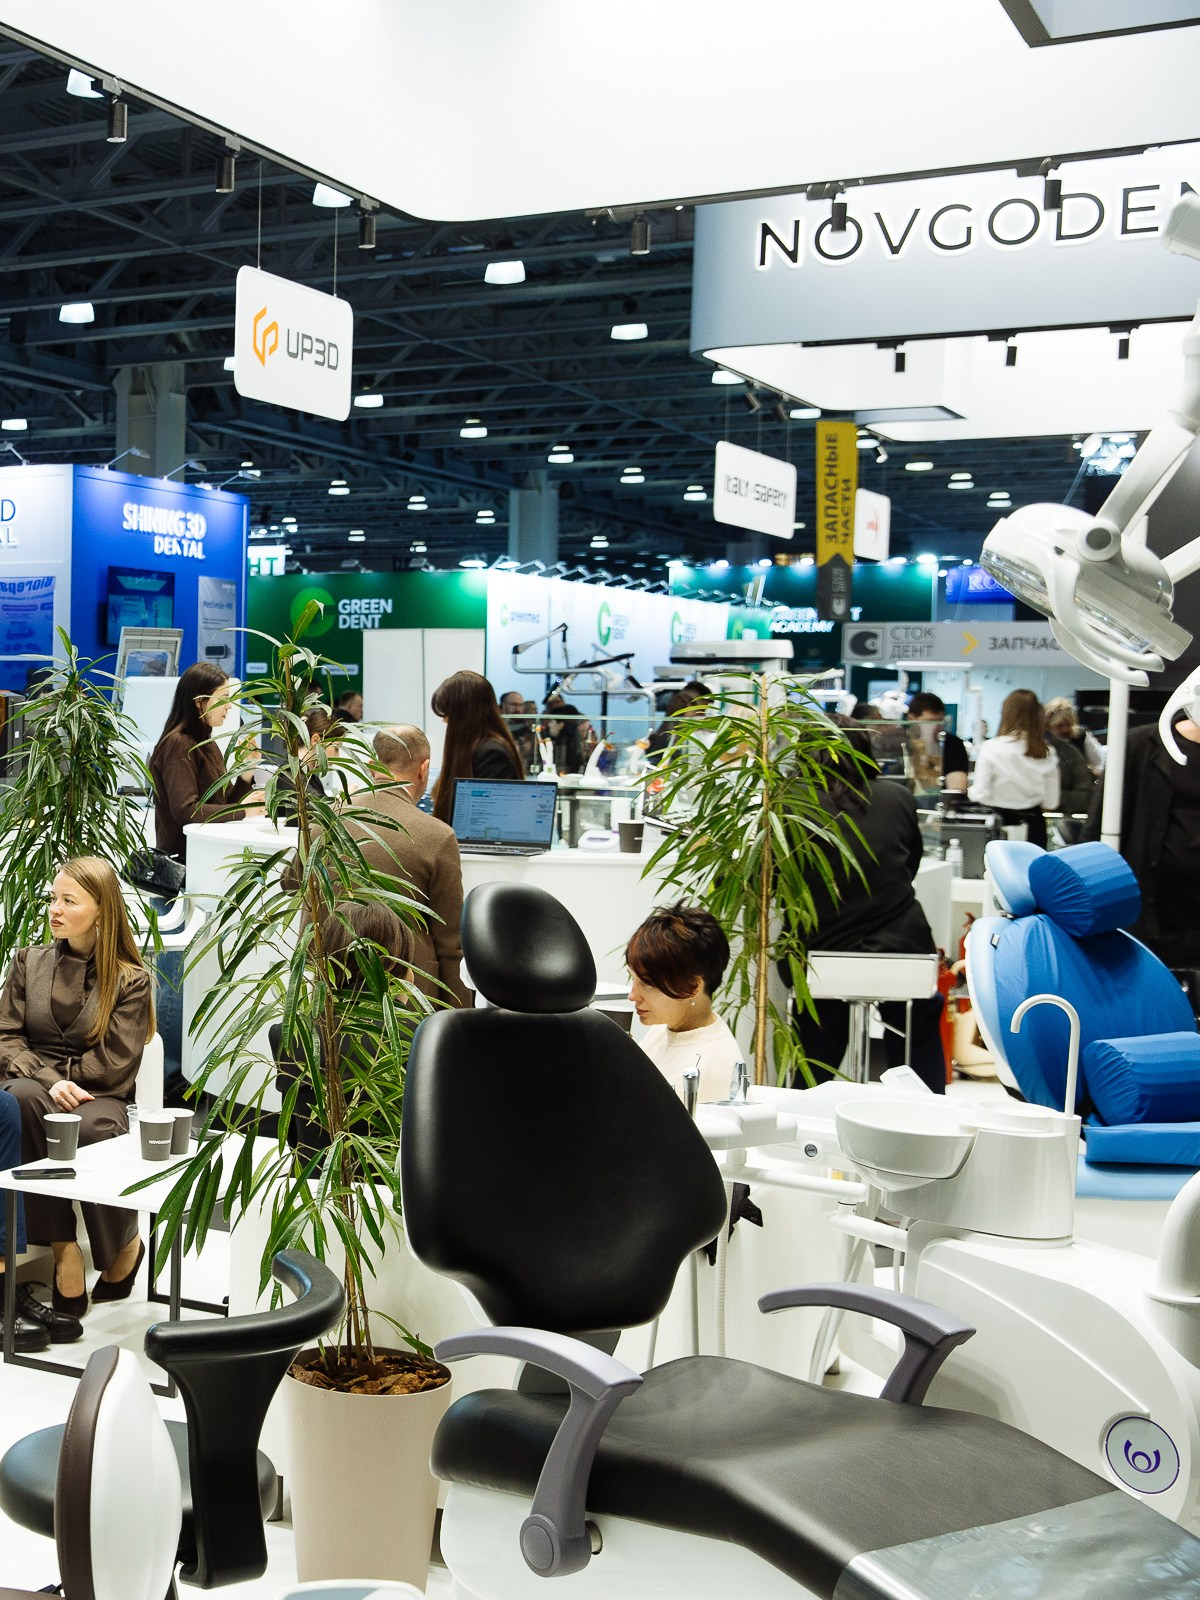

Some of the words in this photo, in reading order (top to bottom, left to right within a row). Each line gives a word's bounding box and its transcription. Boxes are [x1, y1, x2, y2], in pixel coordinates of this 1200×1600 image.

[759, 181, 1200, 267] NOVGODE
[286, 328, 339, 371] UP3D
[122, 502, 186, 538] SHINING
[185, 510, 207, 541] 3D
[154, 535, 206, 560] DENTAL
[338, 598, 393, 614] GREEN
[339, 614, 382, 629] DENT
[889, 626, 936, 641] СТОК
[888, 644, 934, 660] ДЕНТ
